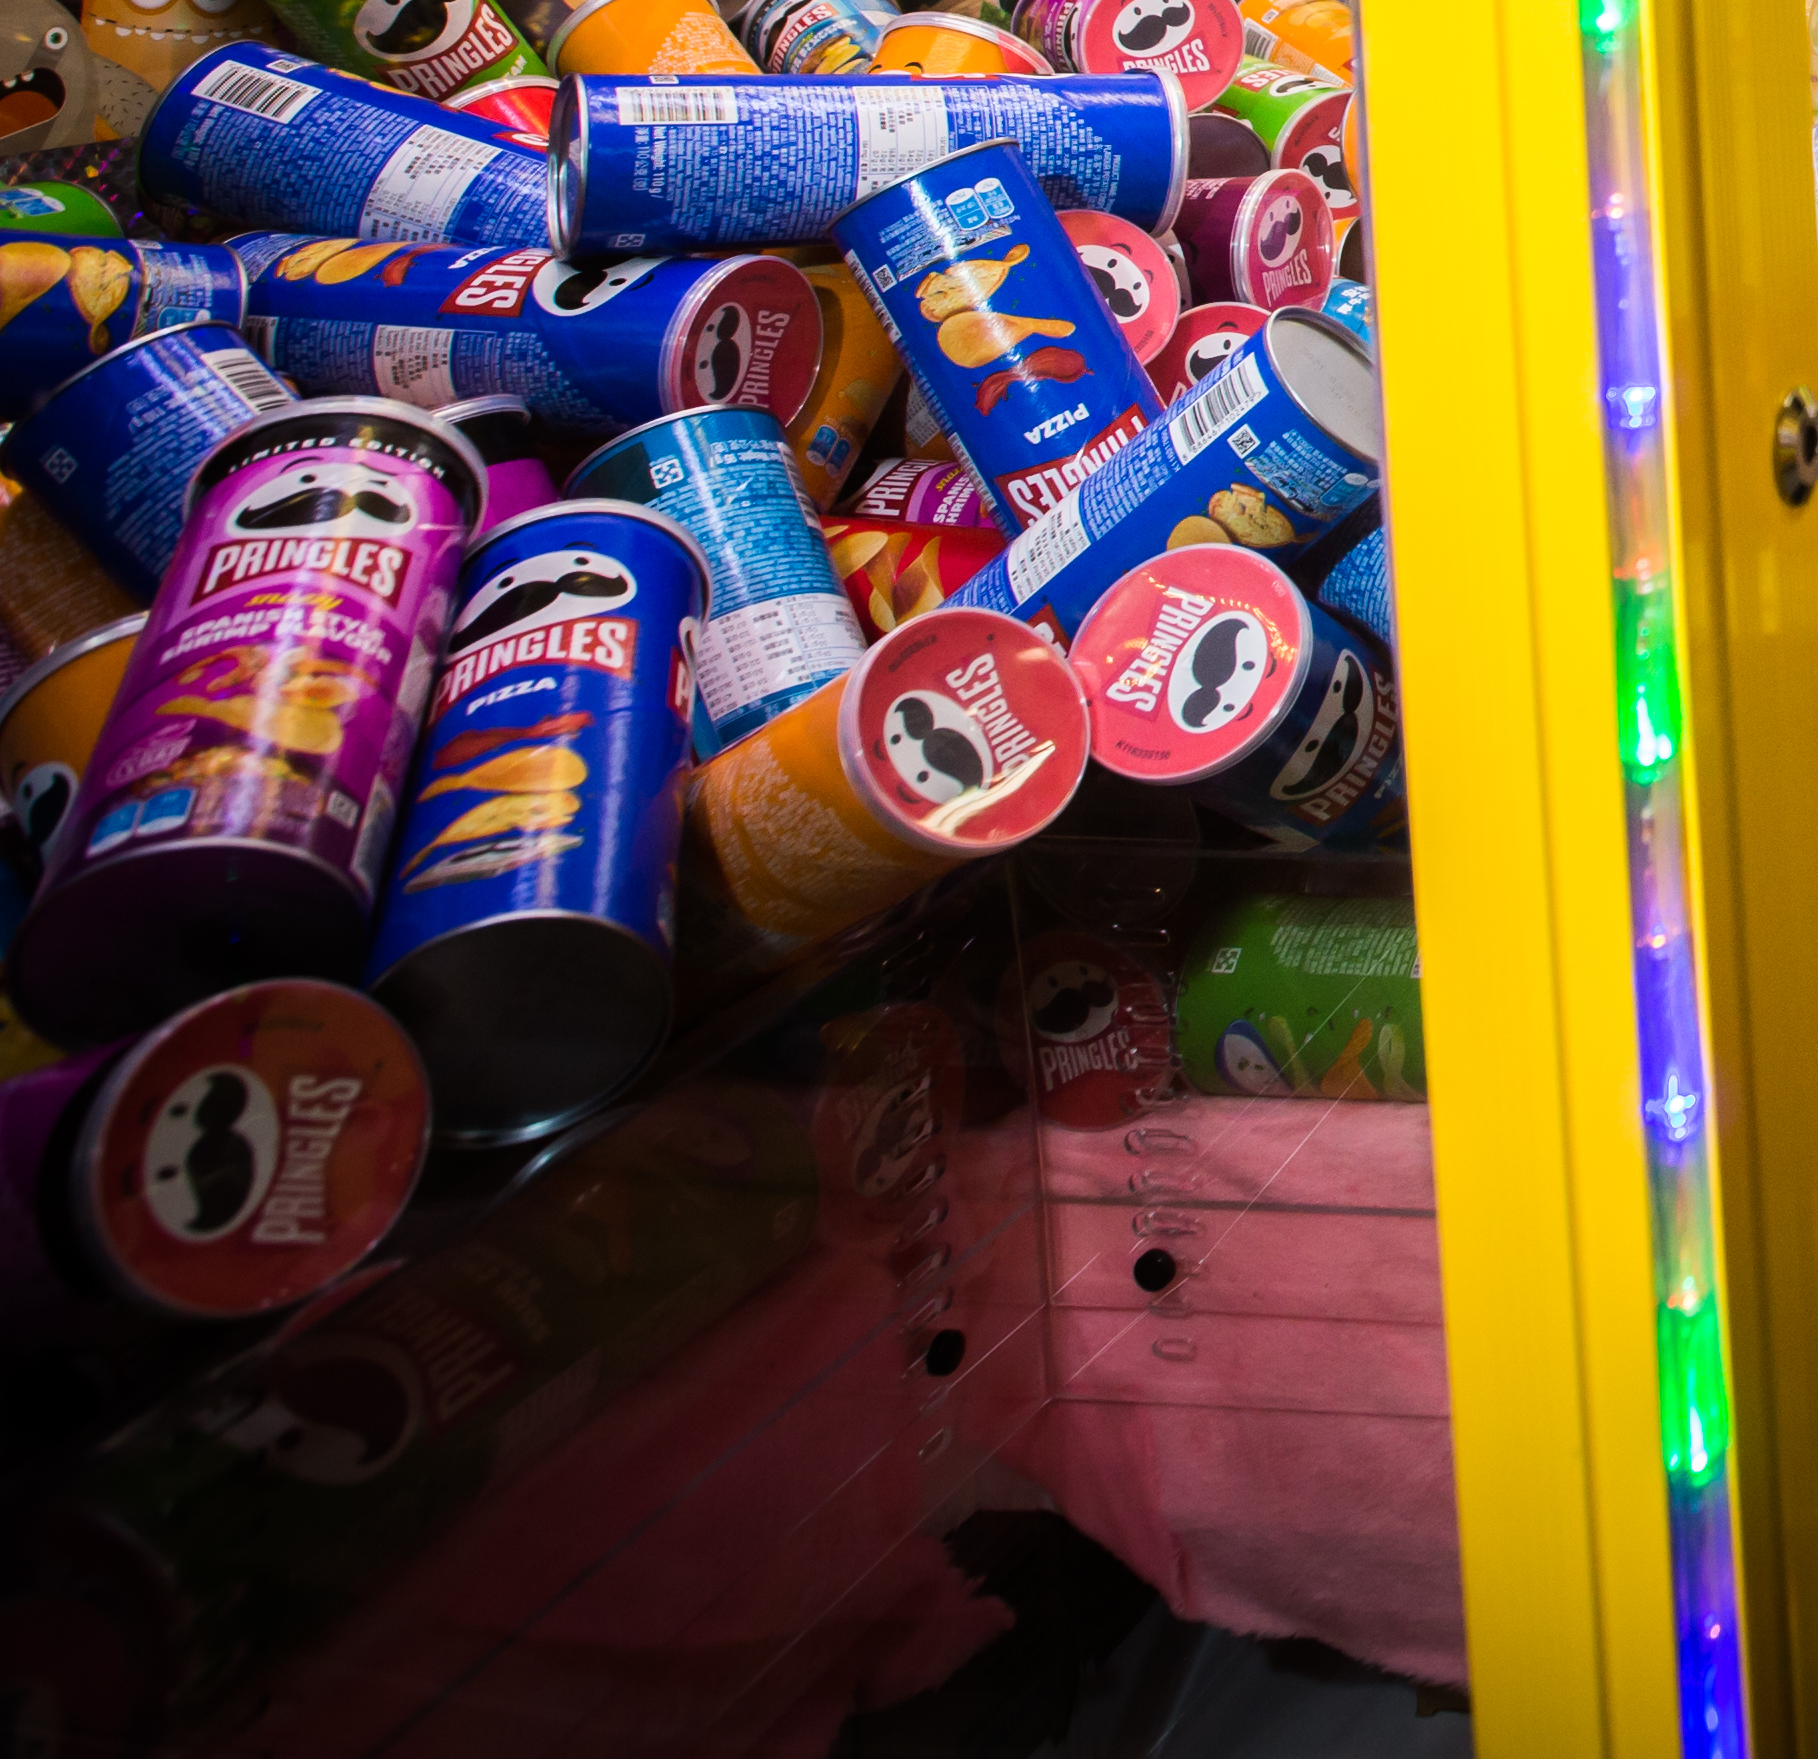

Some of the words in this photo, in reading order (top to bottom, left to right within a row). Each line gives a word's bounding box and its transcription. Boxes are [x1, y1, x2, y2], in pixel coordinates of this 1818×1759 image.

[387, 3, 514, 99] PRINGLES
[1261, 248, 1312, 308] PRINGLES
[739, 309, 791, 409] PRINGLES
[228, 436, 337, 475] LIMITED
[348, 436, 446, 479] EDITION
[1023, 402, 1091, 445] PIZZA
[202, 539, 404, 598] PRINGLES
[429, 621, 628, 712] PRINGLES
[1105, 585, 1217, 712] PRINGLES
[464, 676, 558, 716] PIZZA
[251, 1073, 362, 1244] PRINGLES
